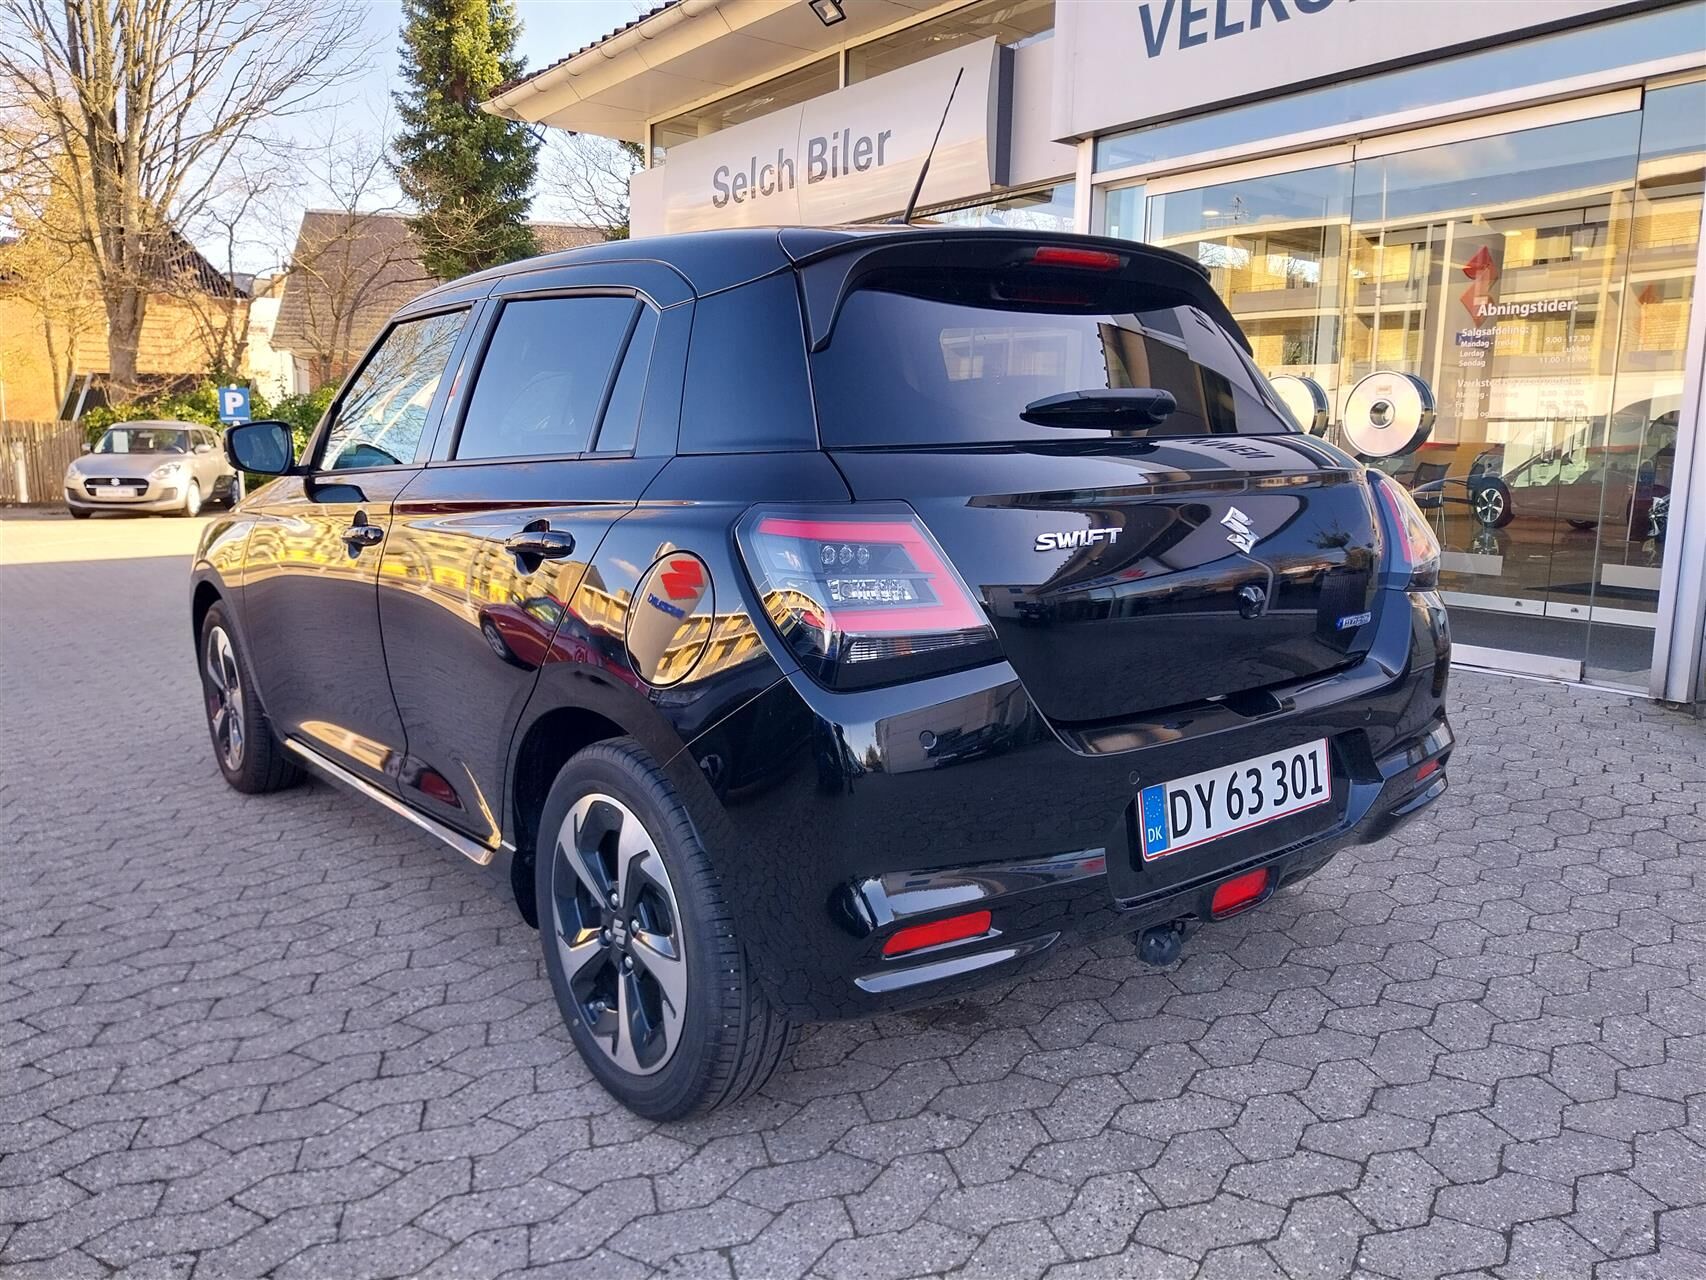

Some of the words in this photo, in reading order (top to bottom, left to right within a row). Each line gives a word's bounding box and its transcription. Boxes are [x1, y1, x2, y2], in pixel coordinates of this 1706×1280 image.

[712, 148, 795, 209] Selch
[807, 127, 892, 185] Biler
[225, 392, 244, 415] P
[1034, 527, 1122, 552] SWIFT
[1169, 780, 1216, 839] DY
[1226, 768, 1264, 820] 63
[1271, 750, 1323, 807] 301
[1147, 827, 1163, 843] DK
